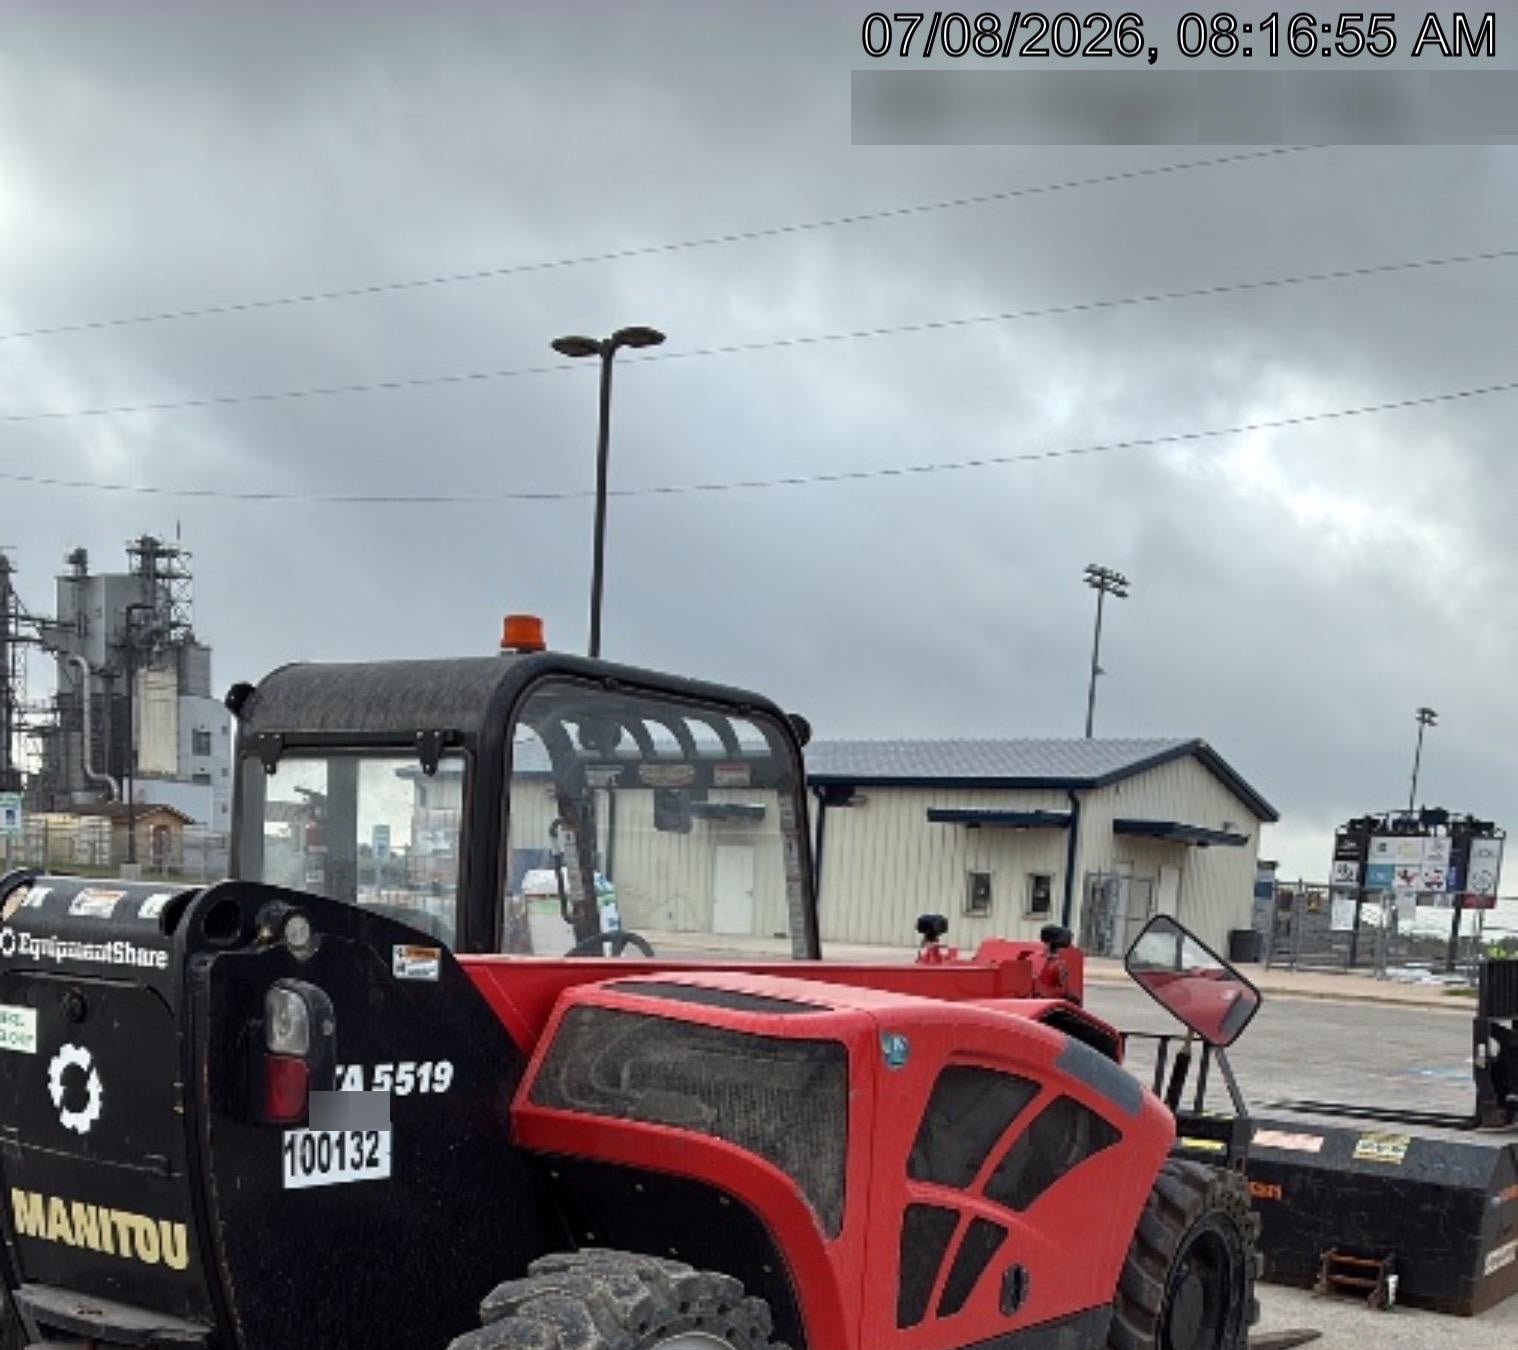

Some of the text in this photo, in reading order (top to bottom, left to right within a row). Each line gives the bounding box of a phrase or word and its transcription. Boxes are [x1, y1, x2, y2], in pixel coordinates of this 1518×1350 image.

[17, 931, 169, 970] EquipmentShare
[371, 1060, 454, 1096] 5519
[284, 1130, 380, 1177] 100132
[11, 1186, 190, 1271] MANITOU
